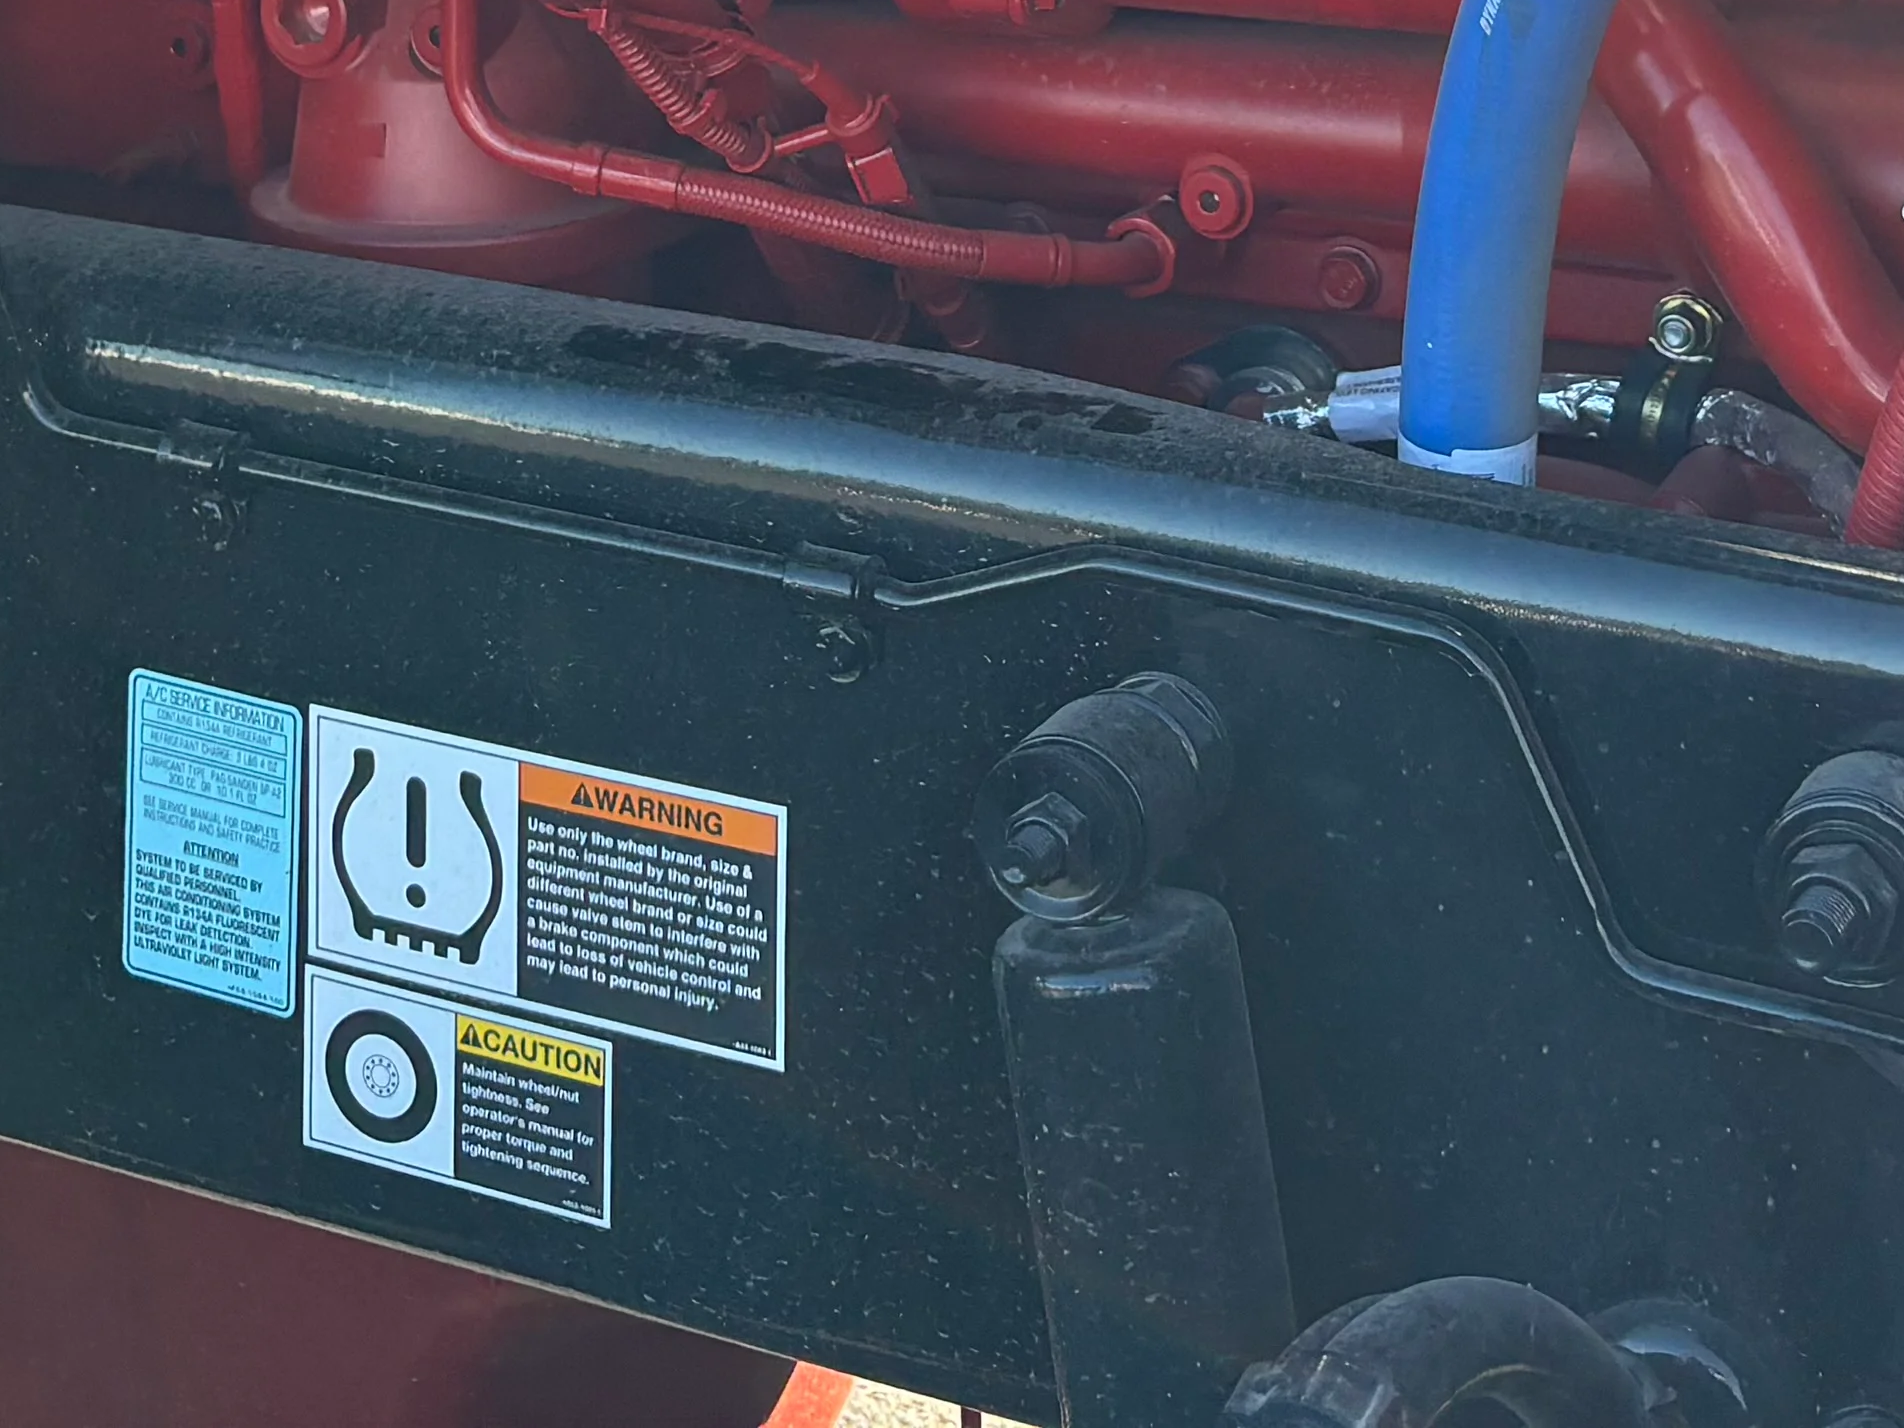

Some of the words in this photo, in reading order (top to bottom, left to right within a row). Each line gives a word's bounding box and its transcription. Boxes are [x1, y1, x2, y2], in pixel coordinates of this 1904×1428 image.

[146, 683, 167, 703] A/C
[169, 689, 211, 713] SERVICE
[214, 701, 284, 732] INFORMATION
[159, 798, 187, 815] SERVICE
[190, 805, 221, 825] MANUAL
[224, 814, 239, 828] FOR
[241, 819, 279, 840] COMPLETE
[198, 823, 214, 836] AND
[216, 827, 243, 843] SAFETY
[594, 786, 723, 837] WARNING
[136, 849, 172, 868] SYSTEM
[175, 858, 186, 872] TO
[189, 863, 200, 876] BE
[204, 867, 248, 890] SERVICED
[250, 879, 263, 893] BY
[183, 840, 239, 865] ATTENTION
[527, 839, 555, 857] part
[558, 843, 580, 861] no.
[584, 848, 643, 876] installed
[647, 862, 663, 883] by
[668, 867, 690, 885] the
[695, 876, 748, 898] original
[528, 816, 555, 832] Use
[557, 824, 588, 846] only
[591, 831, 613, 849] the
[617, 838, 658, 859] wheel
[661, 848, 706, 872] brand,
[711, 858, 739, 876] size
[742, 864, 753, 880] &
[136, 864, 181, 885] QUALIFIED
[527, 858, 600, 884] equipment
[604, 874, 701, 908] manufacturer.
[705, 896, 732, 914] Use
[737, 906, 751, 918] of
[754, 910, 764, 922] a
[134, 906, 152, 921] DYE
[155, 912, 173, 926] FOR
[175, 918, 196, 934] LEAK
[135, 892, 181, 915] CONTAINS
[216, 915, 280, 942] FLUORESCENT
[136, 878, 155, 893] THIS
[158, 884, 172, 896] AIR
[175, 889, 241, 916] CONDITIONING
[243, 907, 281, 928] SYSTEM
[527, 878, 585, 901] different
[588, 891, 629, 911] wheel
[633, 899, 674, 921] brand
[677, 910, 693, 924] or
[696, 914, 724, 931] size
[727, 923, 768, 943] could
[134, 921, 172, 941] INSPECT
[174, 932, 197, 947] WITH
[200, 939, 207, 951] A
[209, 943, 232, 959] HIGH
[234, 949, 281, 973] INTENSITY
[134, 936, 191, 962] ULTRAVIOLET
[194, 952, 220, 970] LIGHT
[527, 895, 569, 916] cause
[572, 906, 608, 926] valve
[612, 915, 646, 935] stem
[650, 922, 663, 938] to
[667, 927, 726, 953] interfere
[730, 943, 760, 962] with
[527, 916, 536, 930] a
[539, 916, 578, 937] brake
[581, 928, 660, 959] component
[663, 946, 705, 969] which
[709, 956, 749, 978] could
[527, 933, 556, 953] lead
[559, 940, 573, 956] to
[577, 945, 606, 965] loss
[610, 953, 624, 967] of
[628, 957, 678, 981] vehicle
[681, 970, 732, 993] control
[735, 983, 761, 1001] and
[527, 953, 556, 977] may
[559, 959, 589, 980] lead
[592, 967, 606, 983] to
[609, 975, 671, 998] personal
[674, 986, 719, 1012] injury.
[482, 1029, 601, 1079] CAUTION
[462, 1062, 516, 1087] Maintain
[518, 1078, 580, 1104] wheel/nut
[462, 1082, 522, 1109] tightness.
[525, 1099, 549, 1115] See
[461, 1123, 502, 1142] proper
[506, 1132, 546, 1155] torque
[550, 1146, 573, 1161] and
[462, 1103, 525, 1129] operator's
[528, 1120, 574, 1142] manual
[577, 1131, 594, 1147] for
[462, 1140, 524, 1170] tightening
[527, 1159, 590, 1185] sequence.
